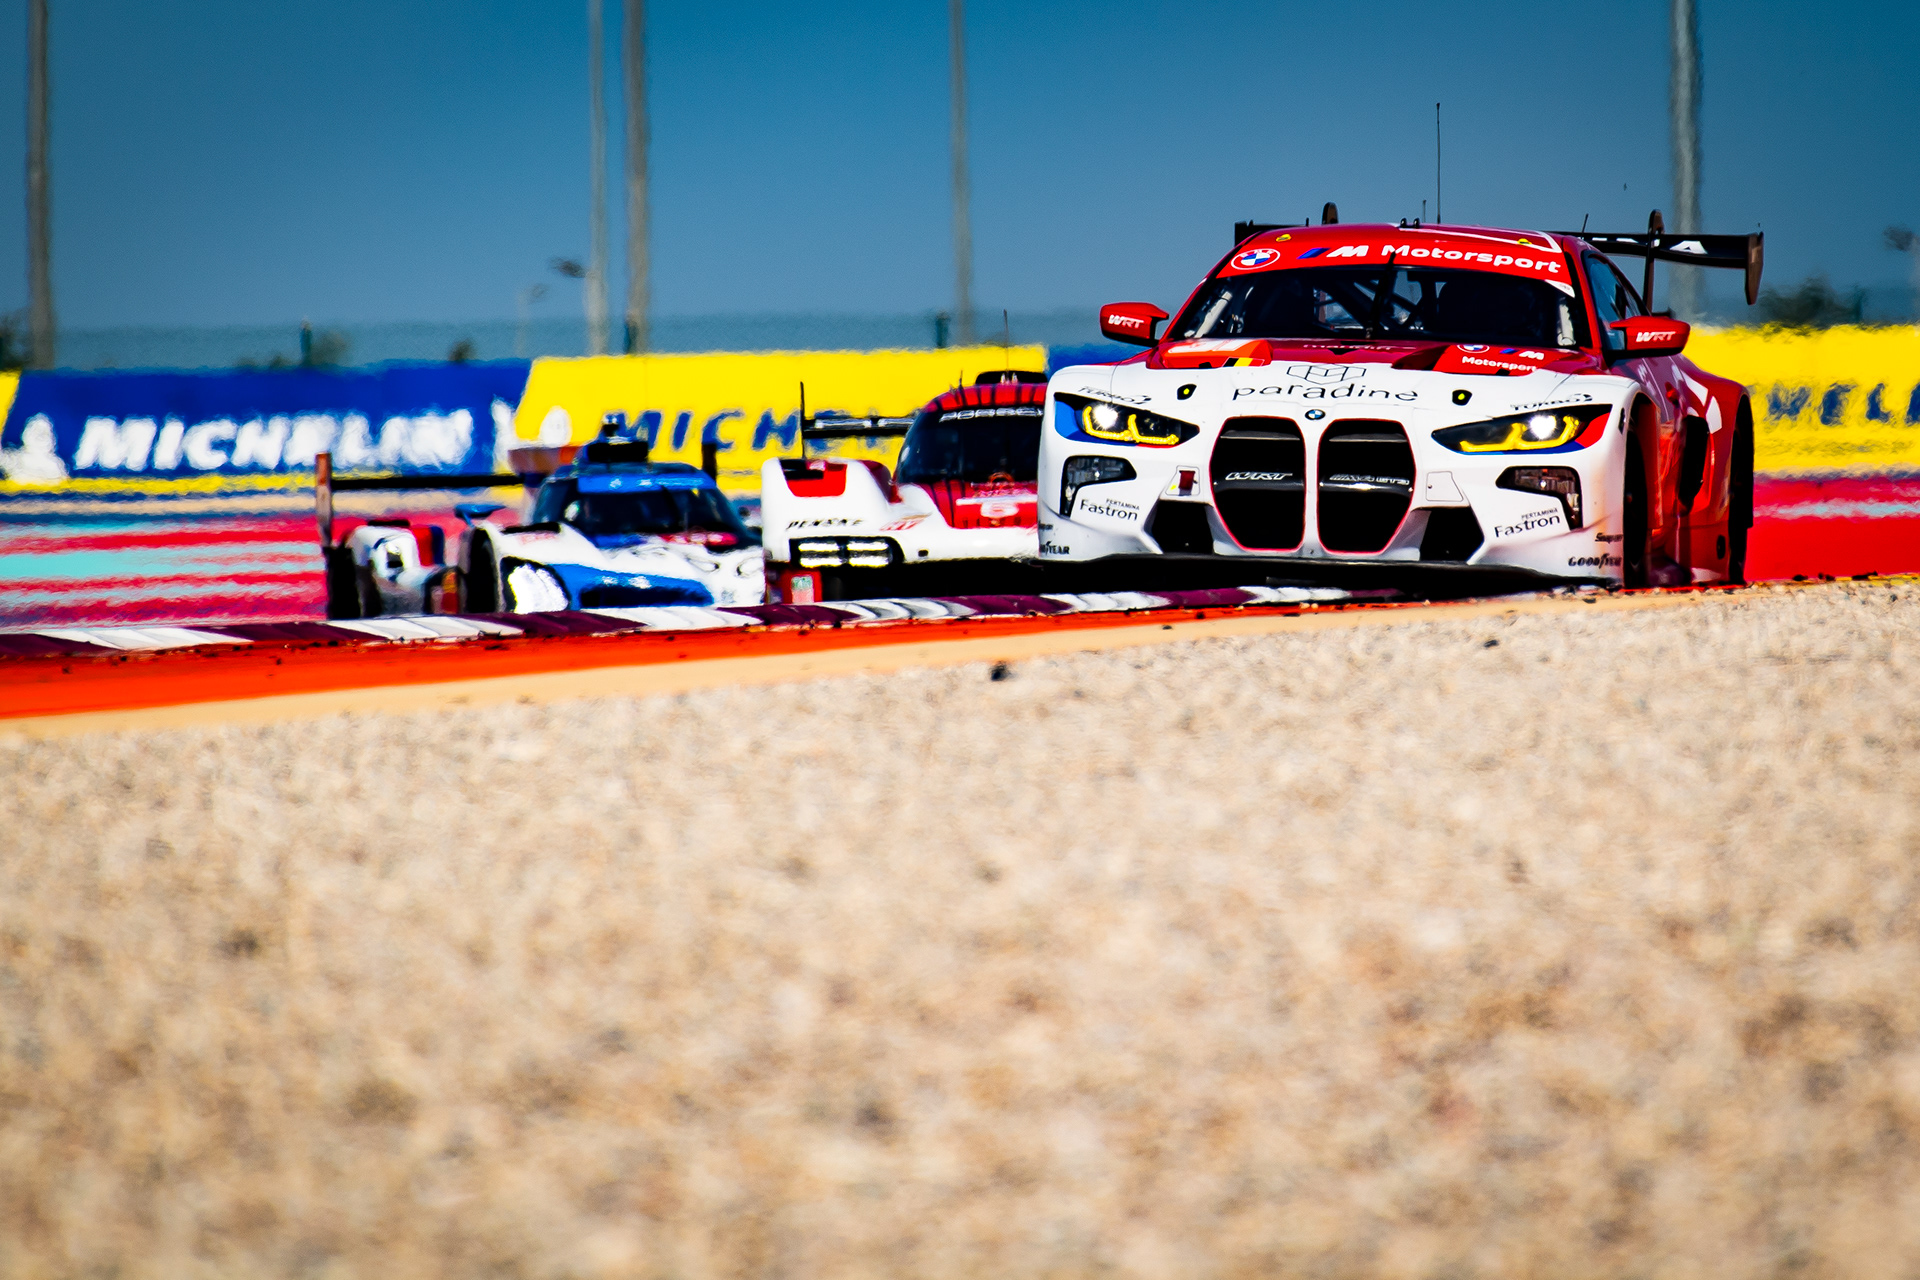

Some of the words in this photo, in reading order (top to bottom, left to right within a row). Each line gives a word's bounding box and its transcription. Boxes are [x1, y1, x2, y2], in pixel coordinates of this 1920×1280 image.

[1381, 244, 1562, 274] Motorsport
[1108, 314, 1145, 328] WRT
[1635, 331, 1676, 343] WRT
[1462, 356, 1537, 372] Motorsport
[1232, 382, 1418, 402] paradine
[74, 411, 475, 472] MICHELIN
[1079, 499, 1138, 522] Fastron
[1106, 498, 1140, 511] PERTAMINA
[1521, 507, 1559, 520] PERTAMINA
[1494, 513, 1561, 539] Fastron
